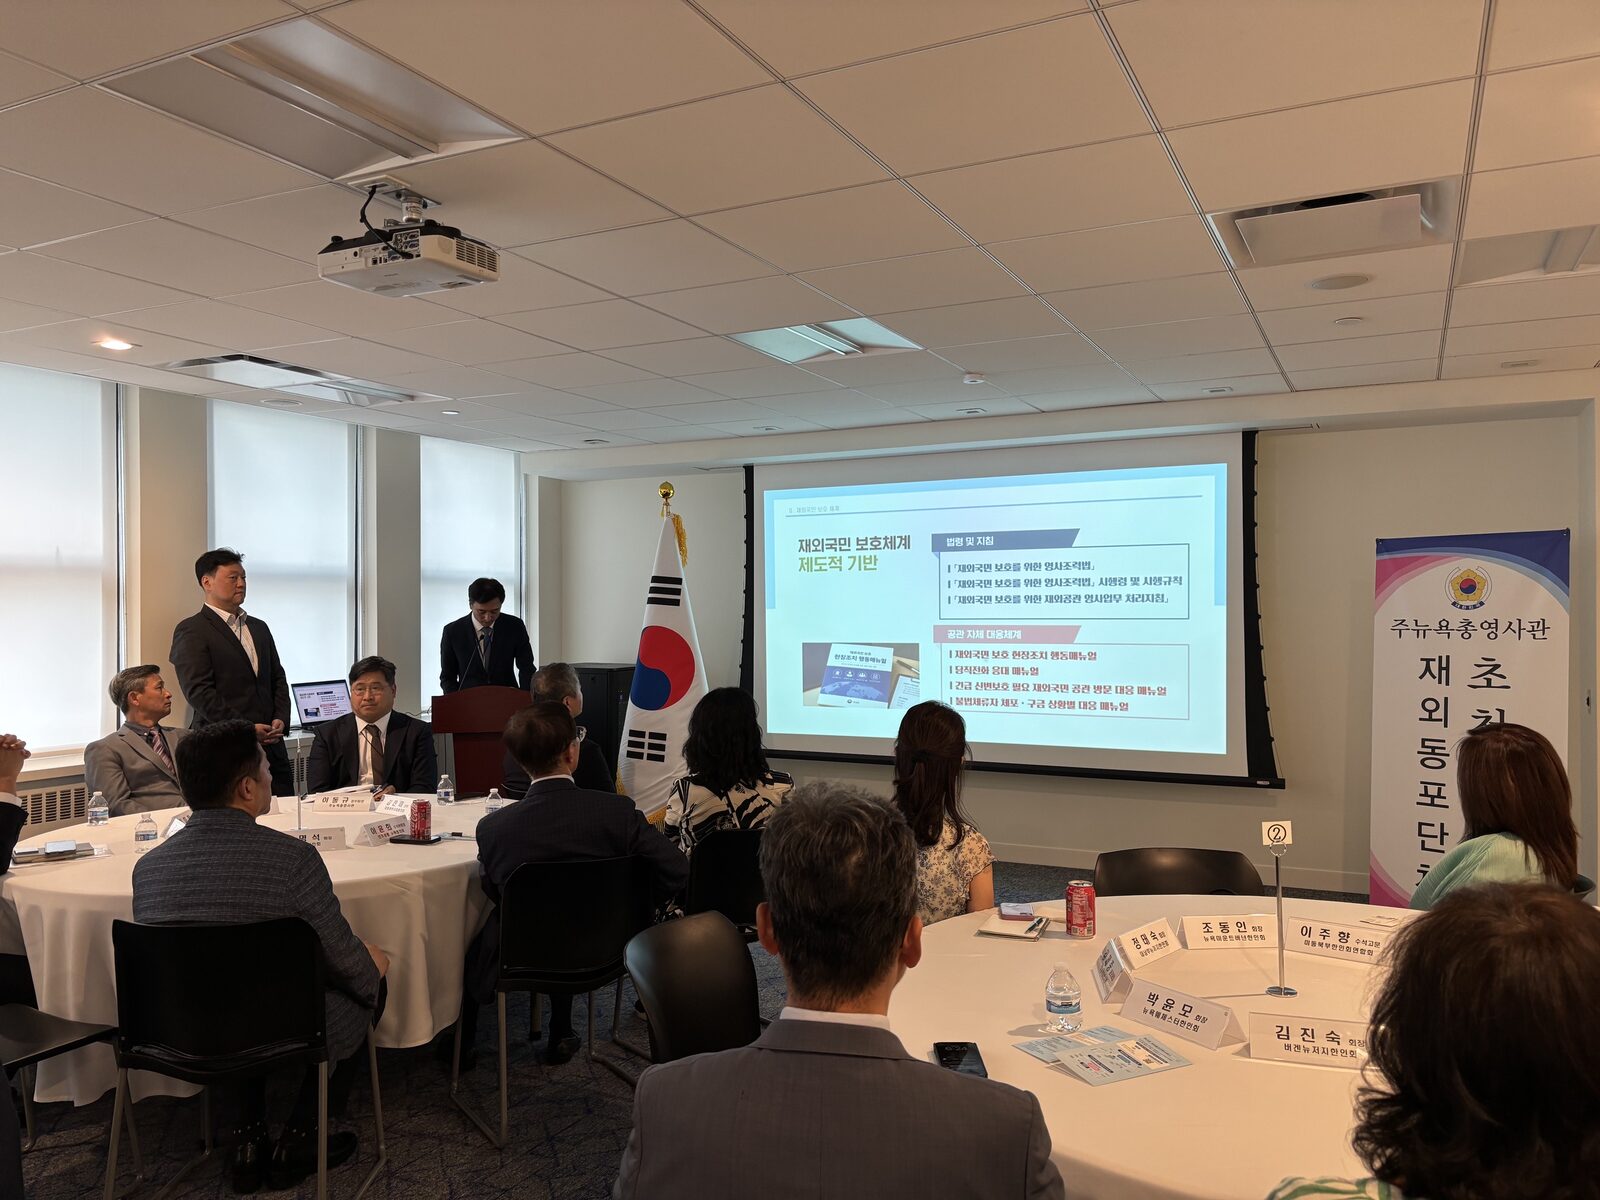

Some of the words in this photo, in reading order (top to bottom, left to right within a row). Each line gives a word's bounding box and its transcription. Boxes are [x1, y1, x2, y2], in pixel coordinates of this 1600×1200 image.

[798, 537, 851, 553] 재외국민
[856, 535, 911, 551] 보호체계
[946, 537, 964, 547] 법령
[966, 536, 975, 546] 및
[976, 536, 994, 546] 지침
[798, 555, 843, 573] 제도적
[848, 554, 879, 571] 기반
[994, 562, 1021, 572] 보호를
[1023, 562, 1042, 572] 위한
[994, 578, 1021, 588] 보호를
[1023, 578, 1042, 587] 위한
[1098, 576, 1127, 586] 시행령
[1130, 576, 1140, 586] 및
[1142, 576, 1183, 586] 시행규칙
[994, 594, 1021, 604] 보호를
[1023, 594, 1042, 604] 위한
[1044, 594, 1082, 604] 재외공관
[1084, 593, 1122, 603] 영사업무
[1390, 617, 1551, 641] 주뉴욕총영사관
[947, 630, 964, 639] 공관
[966, 630, 984, 639] 자체
[986, 630, 1022, 640] 대응체계
[955, 650, 990, 660] 재외국민
[992, 650, 1010, 660] 보호
[1012, 650, 1048, 660] 현장조치
[1050, 651, 1097, 661] 행동매뉴얼
[955, 665, 990, 675] 당직전화
[992, 666, 1010, 676] 응대
[1012, 666, 1039, 676] 매뉴얼
[955, 681, 972, 690] 긴급
[975, 681, 1010, 692] 신변보호
[1012, 682, 1030, 692] 필요
[1032, 683, 1069, 693] 재외국민
[1072, 684, 1091, 694] 공관
[1093, 684, 1112, 695] 방문
[1115, 685, 1135, 695] 대응
[1137, 685, 1167, 697] 매뉴얼
[955, 697, 998, 707] 불법체류자
[1000, 697, 1019, 708] 체포
[1027, 699, 1046, 708] 구금
[1048, 699, 1076, 710] 상황별
[1078, 700, 1097, 710] 대응
[1100, 701, 1129, 712] 매뉴얼
[1251, 925, 1263, 933] 회장
[1194, 1013, 1209, 1025] 회장
[1348, 1038, 1365, 1048] 회장
